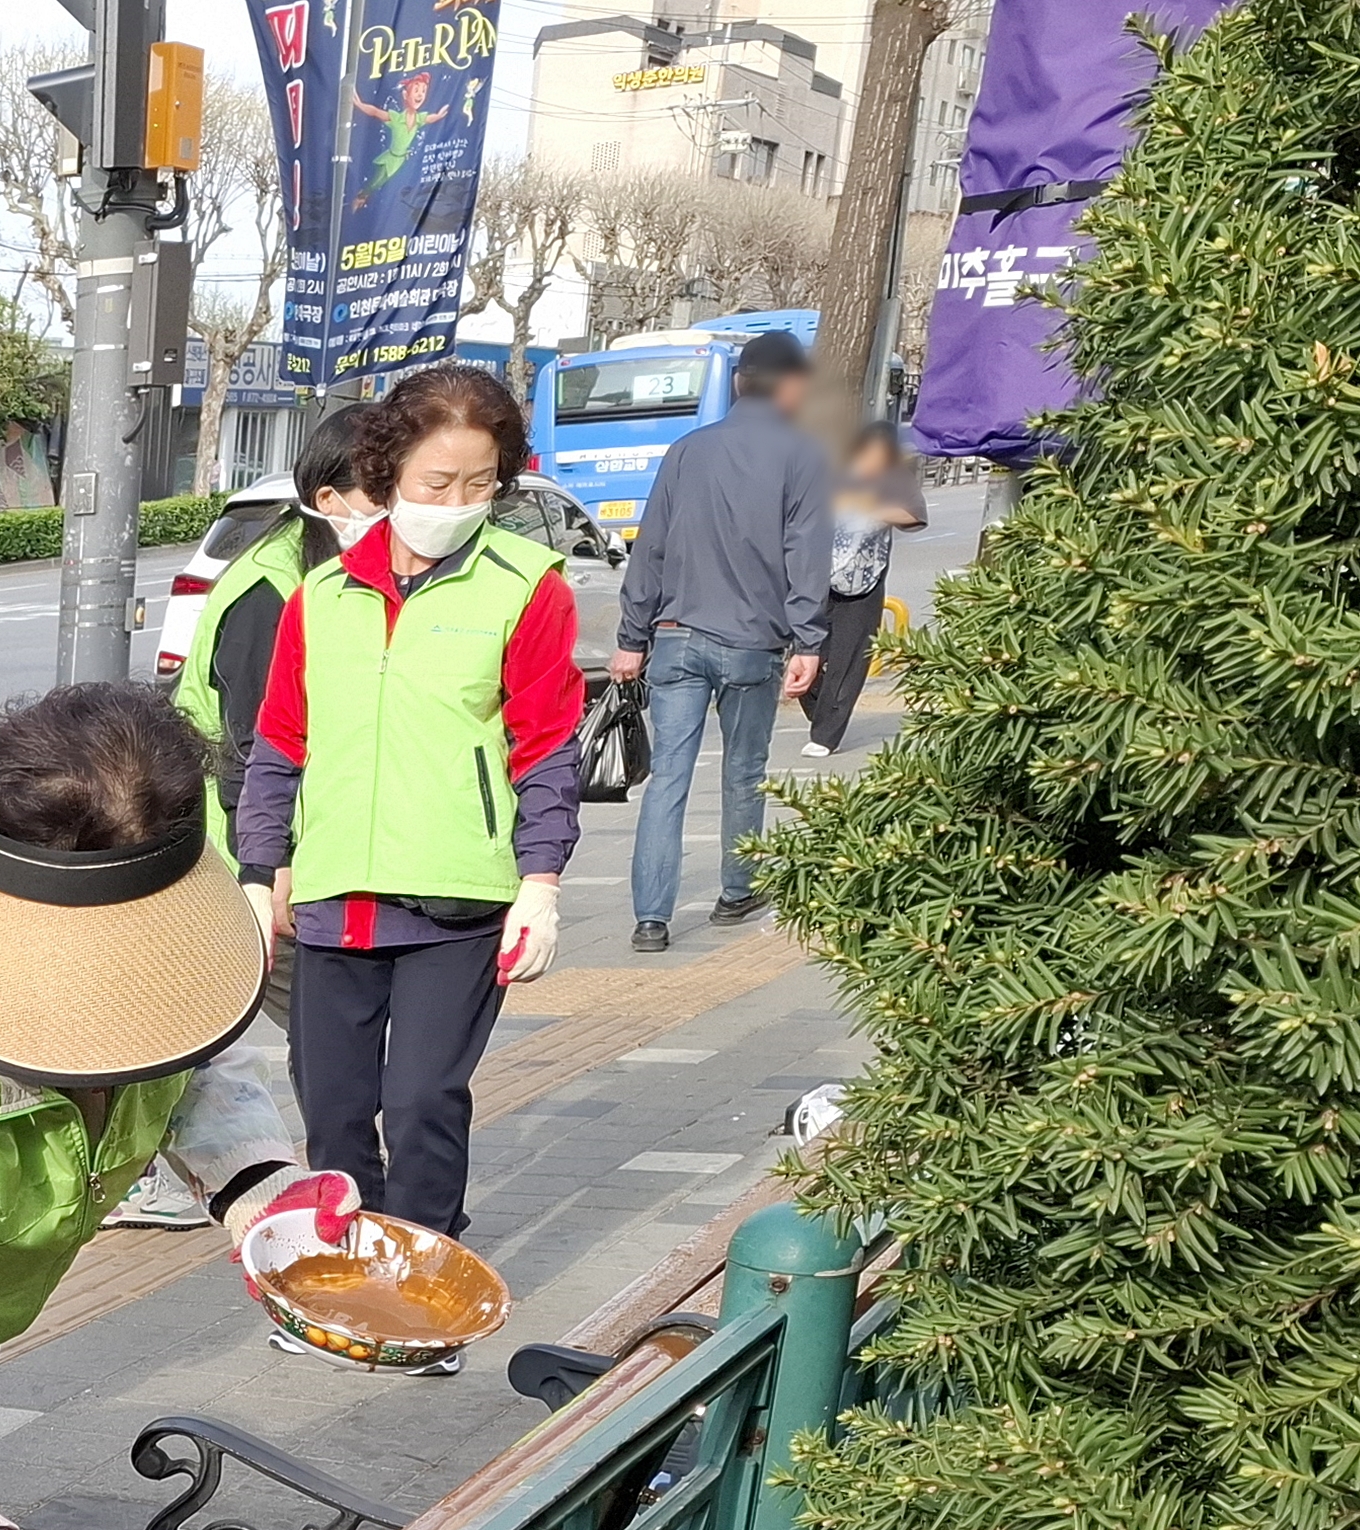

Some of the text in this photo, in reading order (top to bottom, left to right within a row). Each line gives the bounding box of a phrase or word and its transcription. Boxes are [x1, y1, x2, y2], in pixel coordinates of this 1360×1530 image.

[359, 23, 472, 80] PETER
[373, 334, 446, 363] 1588-6212
[648, 376, 675, 396] 23
